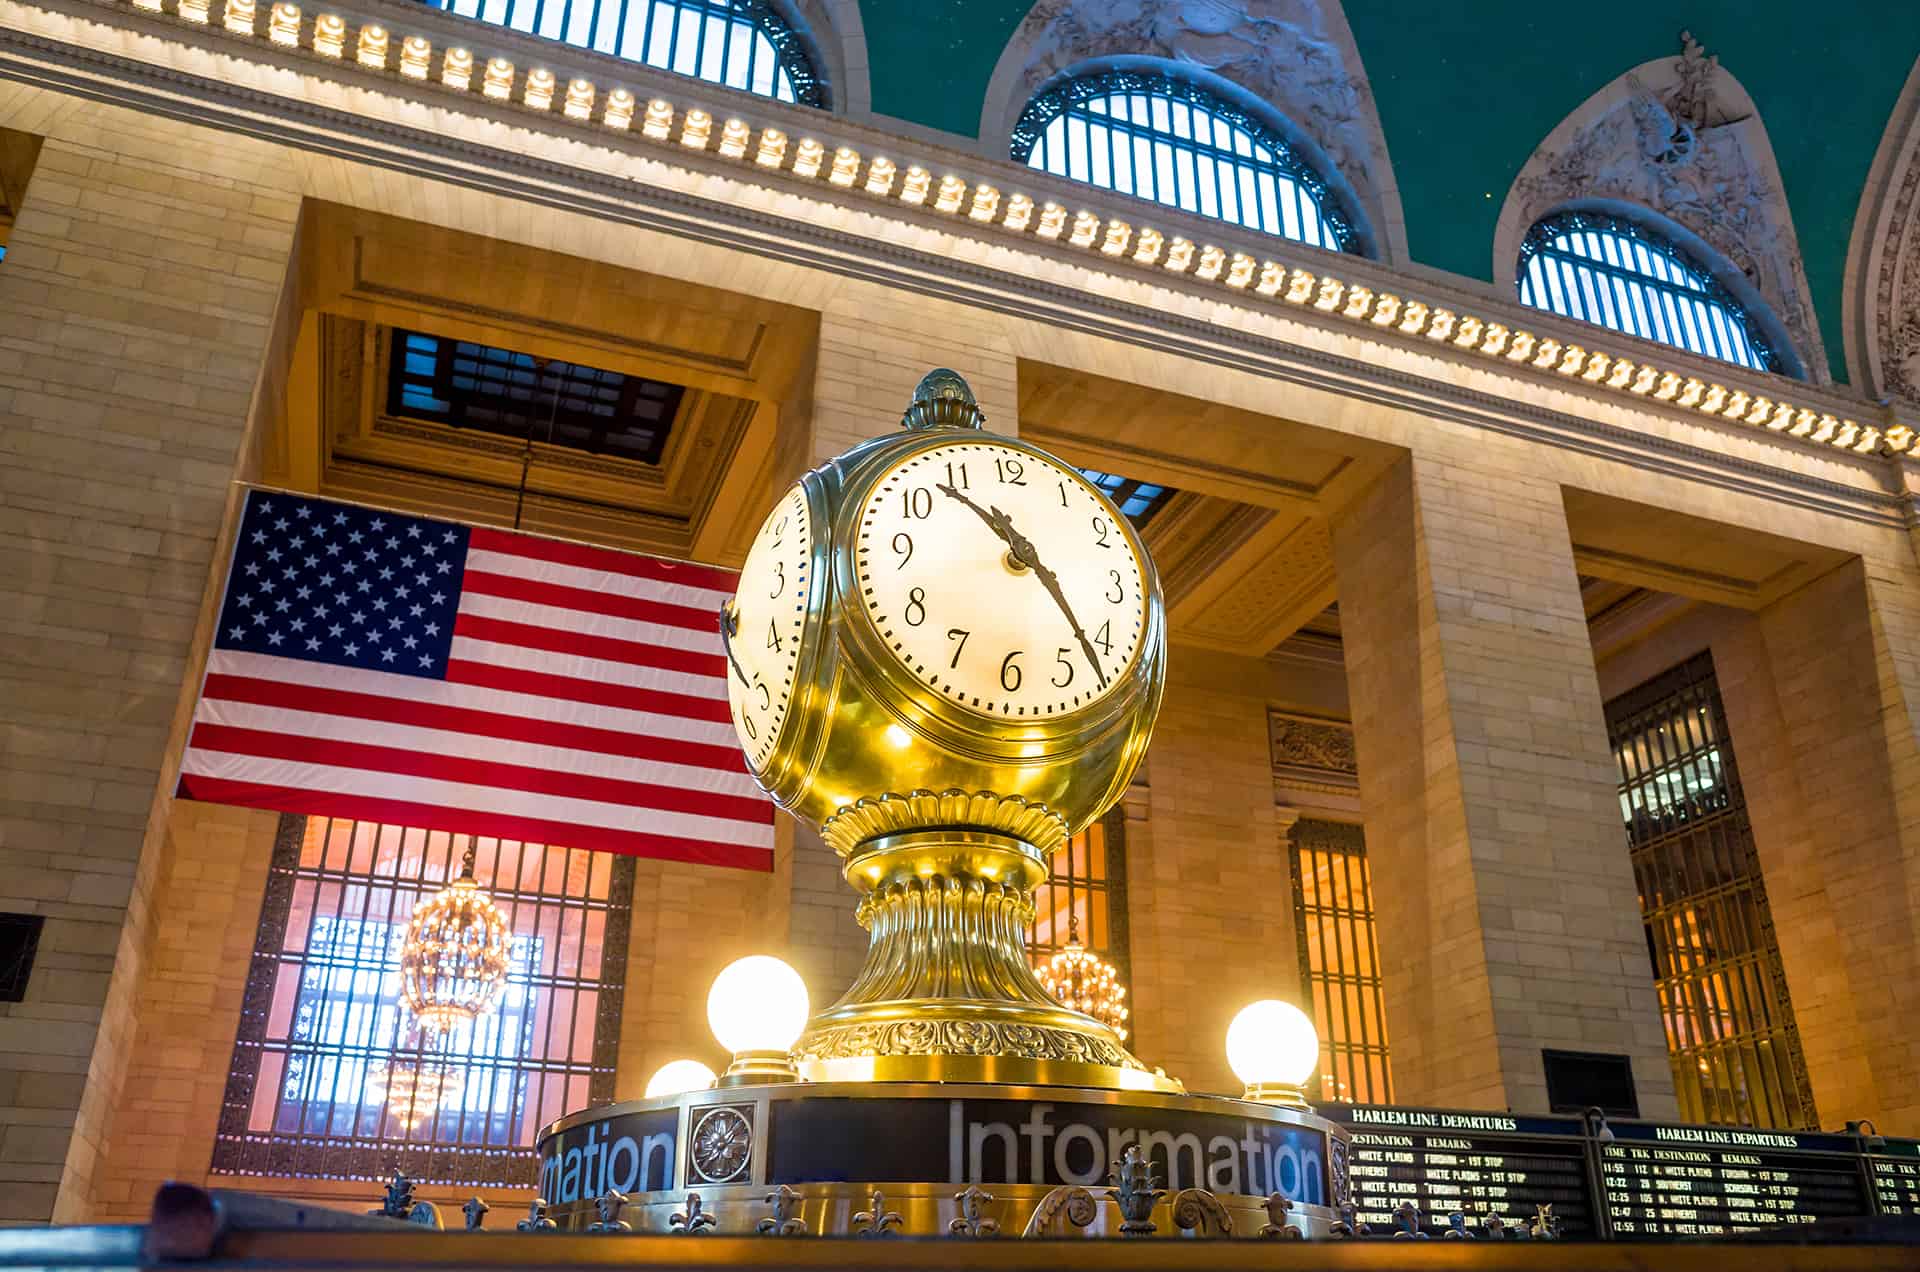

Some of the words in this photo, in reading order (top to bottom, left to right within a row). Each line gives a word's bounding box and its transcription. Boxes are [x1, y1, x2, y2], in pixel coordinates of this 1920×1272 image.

[944, 461, 970, 491] 11
[995, 457, 1027, 487] 12
[901, 487, 932, 519] 10
[1056, 481, 1069, 508] 1
[1092, 517, 1111, 548] 2
[892, 533, 914, 570] 9
[770, 561, 785, 599] 3
[1105, 569, 1124, 604] 3
[905, 587, 926, 626] 8
[767, 616, 782, 653] 4
[947, 628, 970, 669] 7
[1094, 618, 1114, 656] 4
[1000, 651, 1024, 692] 6
[1051, 647, 1074, 688] 5
[752, 672, 770, 711] 5
[742, 702, 757, 740] 6
[1352, 1109, 1407, 1125] HARLEM
[1409, 1112, 1440, 1127] LINE
[1441, 1115, 1517, 1130] DEPARTURES
[1656, 1127, 1704, 1142] HARLEM
[1704, 1130, 1731, 1144] LINE
[1731, 1132, 1798, 1147] DEPARTURES
[949, 1101, 1325, 1206] Information
[1426, 1137, 1472, 1149] REMARKS
[1603, 1147, 1627, 1158] TIME
[1630, 1148, 1650, 1159] TRK
[1653, 1150, 1712, 1162] DESTINATION
[1721, 1153, 1762, 1165] REMARKS
[543, 1122, 675, 1206] mation
[1874, 1163, 1896, 1173] TIME
